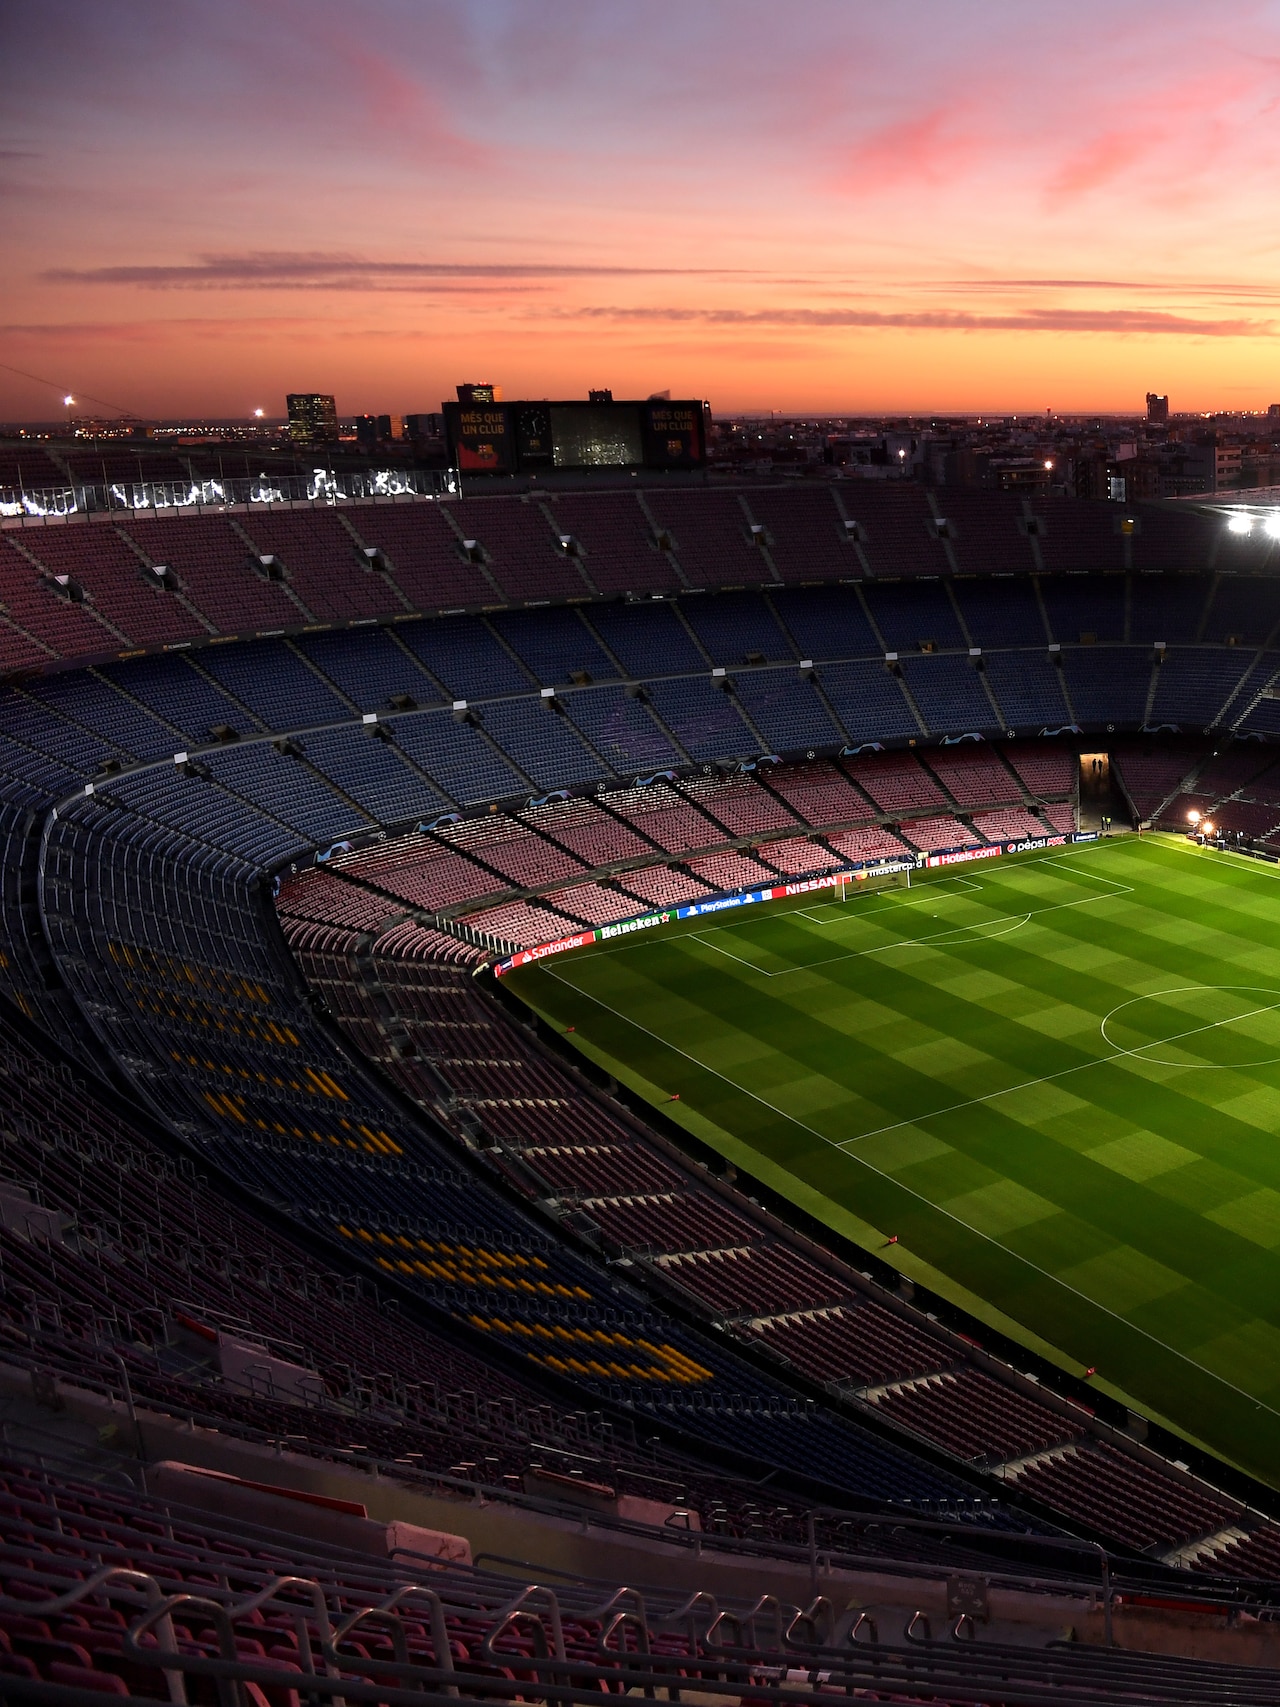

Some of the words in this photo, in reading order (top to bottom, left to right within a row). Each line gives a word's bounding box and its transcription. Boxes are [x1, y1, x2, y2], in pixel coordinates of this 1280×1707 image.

[460, 411, 482, 423] MÉS
[484, 413, 504, 424] QUE
[673, 411, 693, 421] QUE
[462, 425, 477, 434] UN
[479, 424, 505, 434] CLUB
[653, 422, 667, 431] UN
[669, 421, 693, 431] CLUB
[1017, 839, 1046, 853] pepsi
[942, 847, 997, 865] Hotels.com
[786, 876, 837, 895] NISSAN
[701, 897, 741, 913] PlayStation
[601, 917, 660, 939] Heineken
[532, 936, 584, 960] Santander
